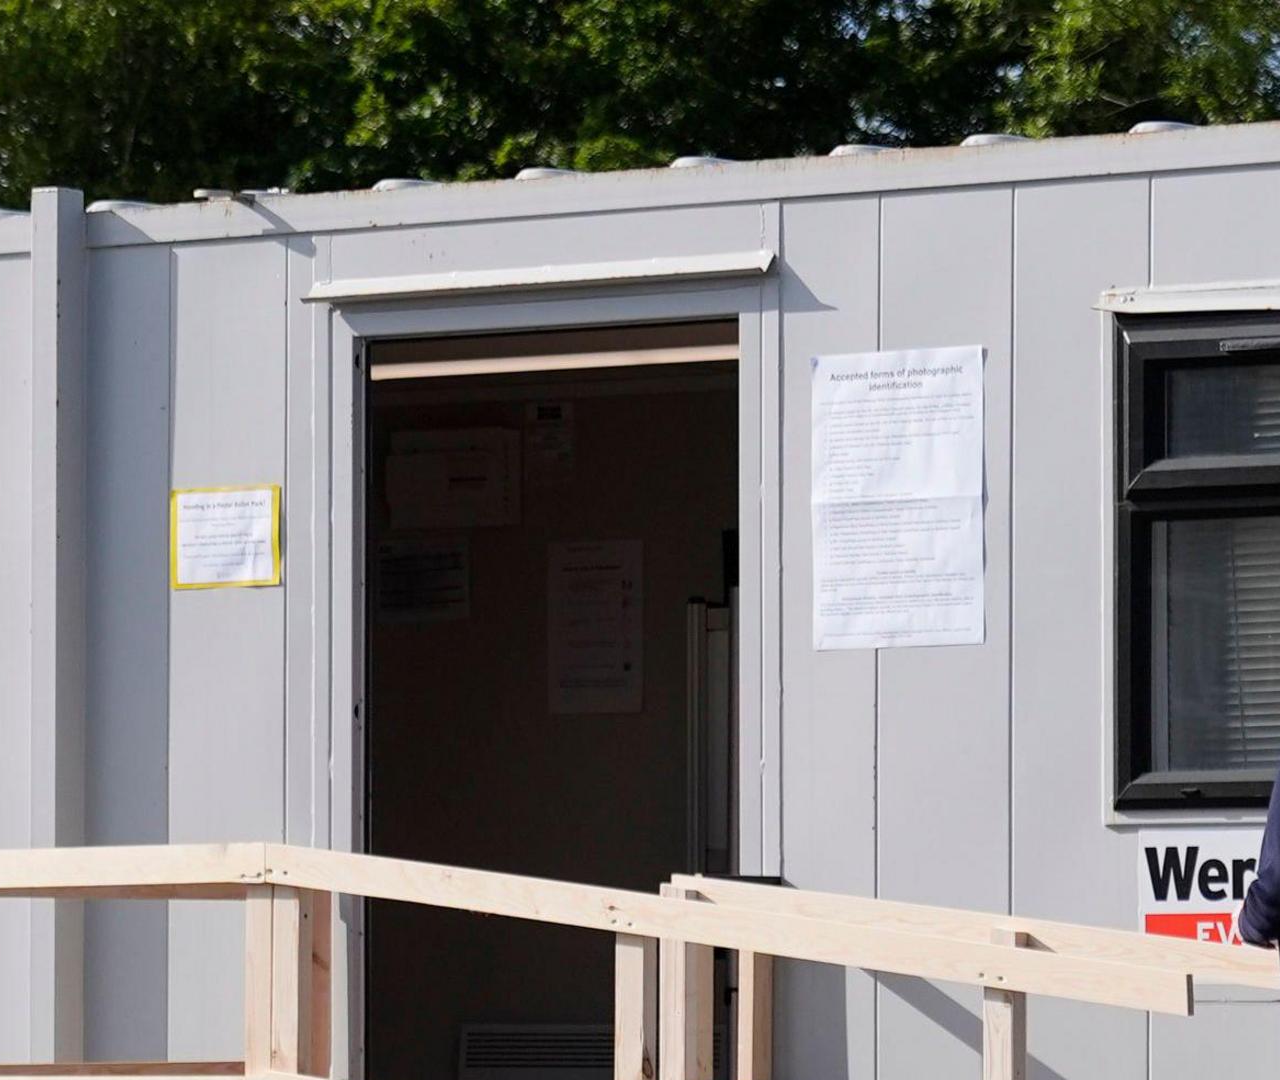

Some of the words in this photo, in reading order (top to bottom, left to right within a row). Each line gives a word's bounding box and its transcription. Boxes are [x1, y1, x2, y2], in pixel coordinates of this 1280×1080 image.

[830, 370, 868, 382] Accepted
[870, 369, 894, 380] forms
[897, 368, 907, 378] of
[907, 365, 963, 379] photographic
[869, 380, 923, 391] identification
